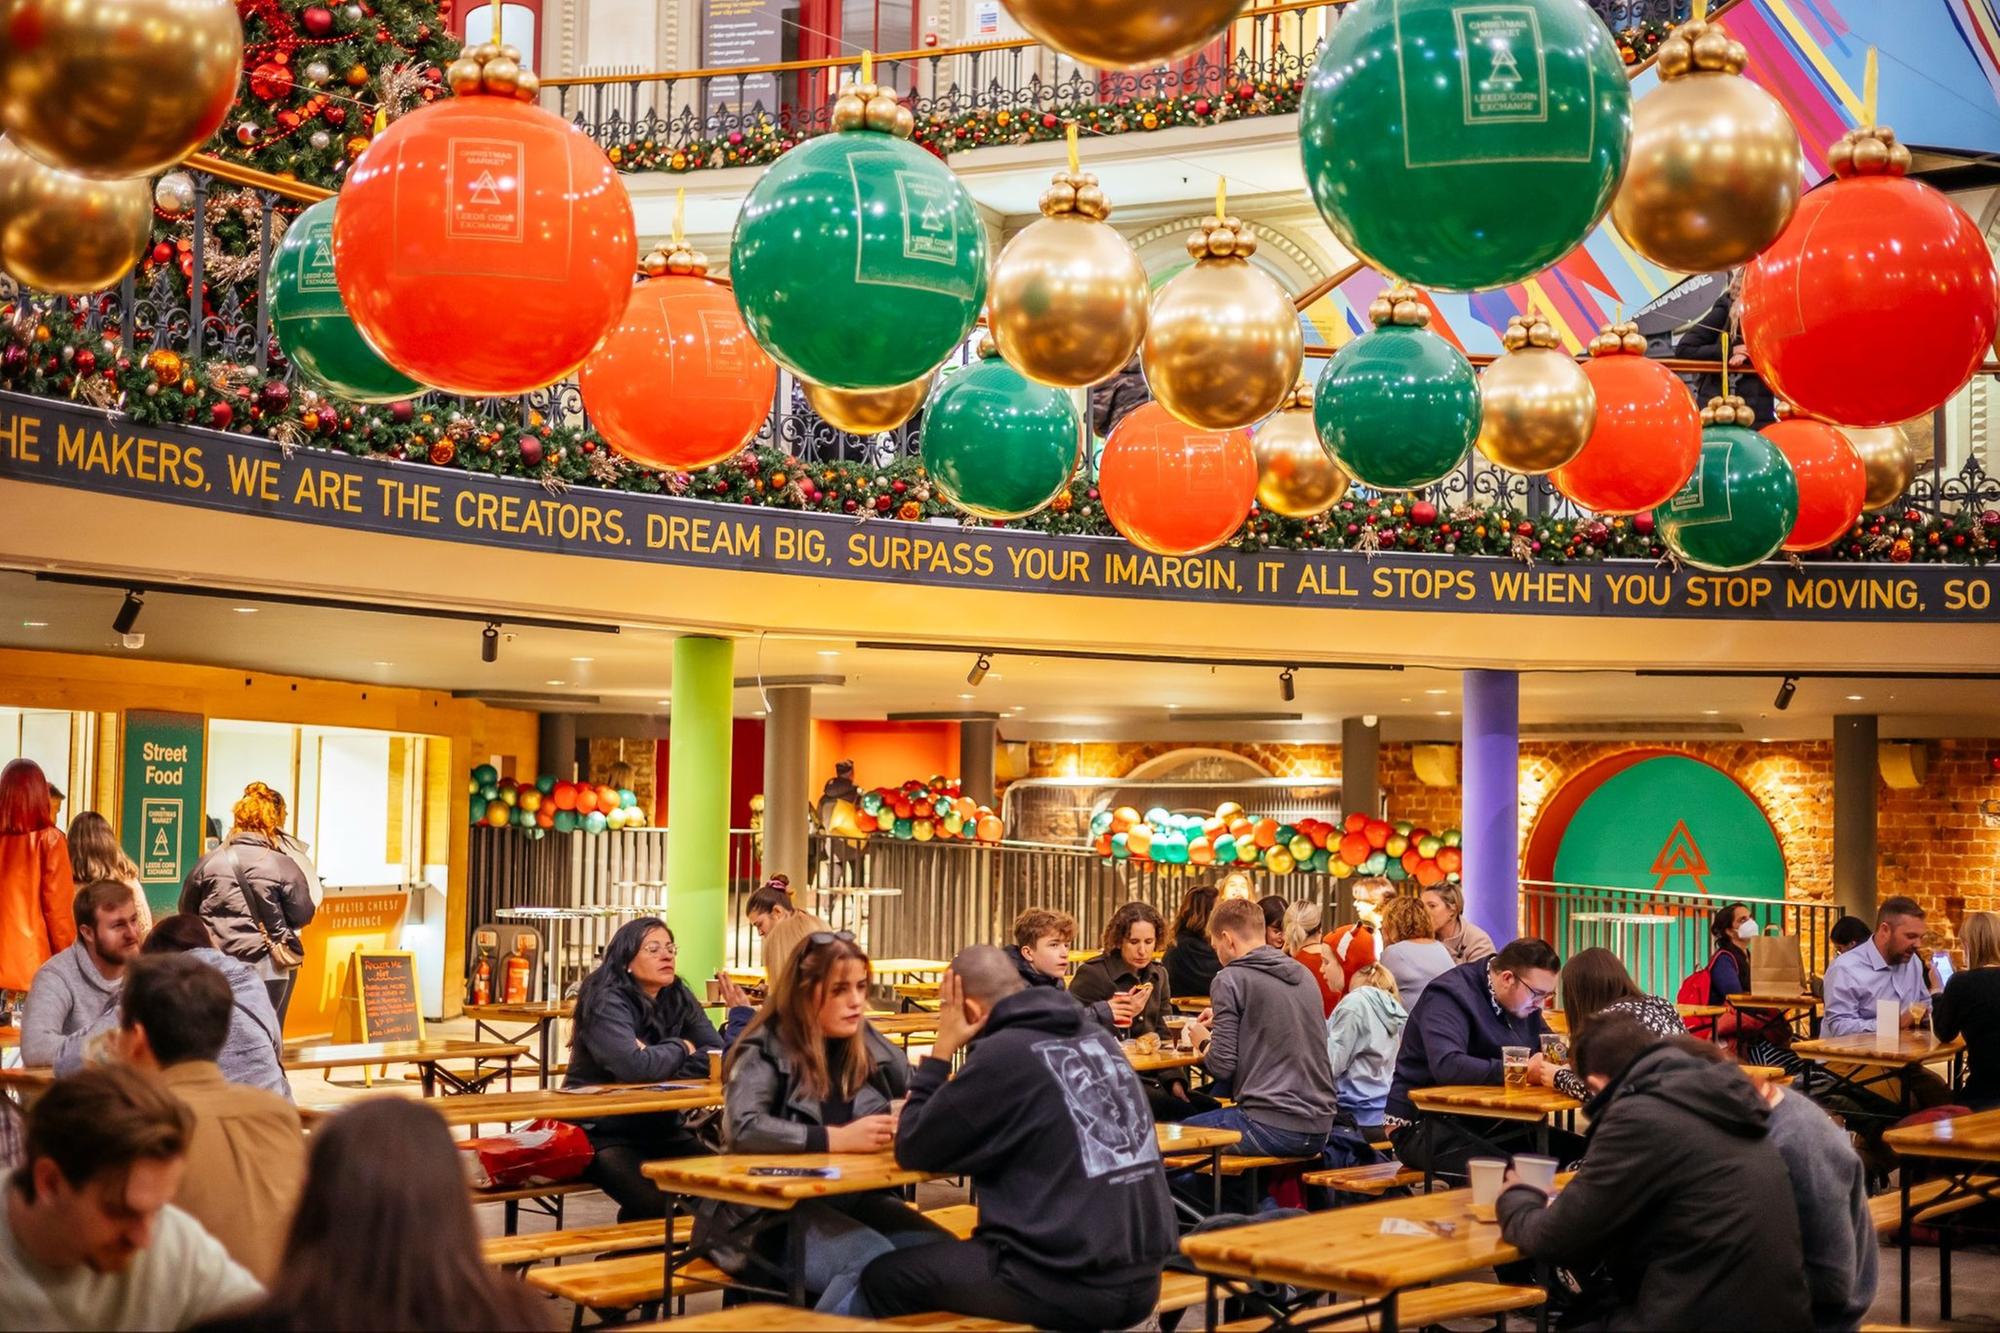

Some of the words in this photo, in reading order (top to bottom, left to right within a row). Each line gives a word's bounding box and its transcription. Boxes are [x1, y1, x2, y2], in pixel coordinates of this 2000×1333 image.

[1468, 20, 1528, 30] CHRISTMAS
[1474, 93, 1507, 102] LEEDS
[1509, 92, 1538, 102] CORN
[1480, 101, 1534, 112] EXCHANGE
[57, 424, 212, 492] MAKERS,
[228, 454, 281, 501] WE
[294, 467, 363, 513] ARE
[377, 479, 440, 524] THE
[455, 490, 631, 546] CREATORS.
[646, 513, 761, 558] DREAM
[775, 527, 832, 566] BIG,
[848, 533, 994, 577] SURPASS
[1008, 546, 1090, 583] YOUR
[1105, 553, 1242, 593] IMARGIN,
[1258, 561, 1285, 592] IT
[1297, 564, 1359, 596] ALL
[1373, 567, 1477, 601] STOPS
[1490, 571, 1591, 603] WHEN
[1606, 574, 1671, 606] YOU
[1686, 577, 1772, 607] STOP
[1787, 578, 1925, 612] MOVING,
[1944, 579, 1990, 609] SO
[143, 742, 188, 762] Street
[146, 765, 183, 785] Food
[335, 902, 364, 913] MELTED
[368, 900, 398, 912] CHEESE
[332, 916, 382, 928] EXPERIENCE
